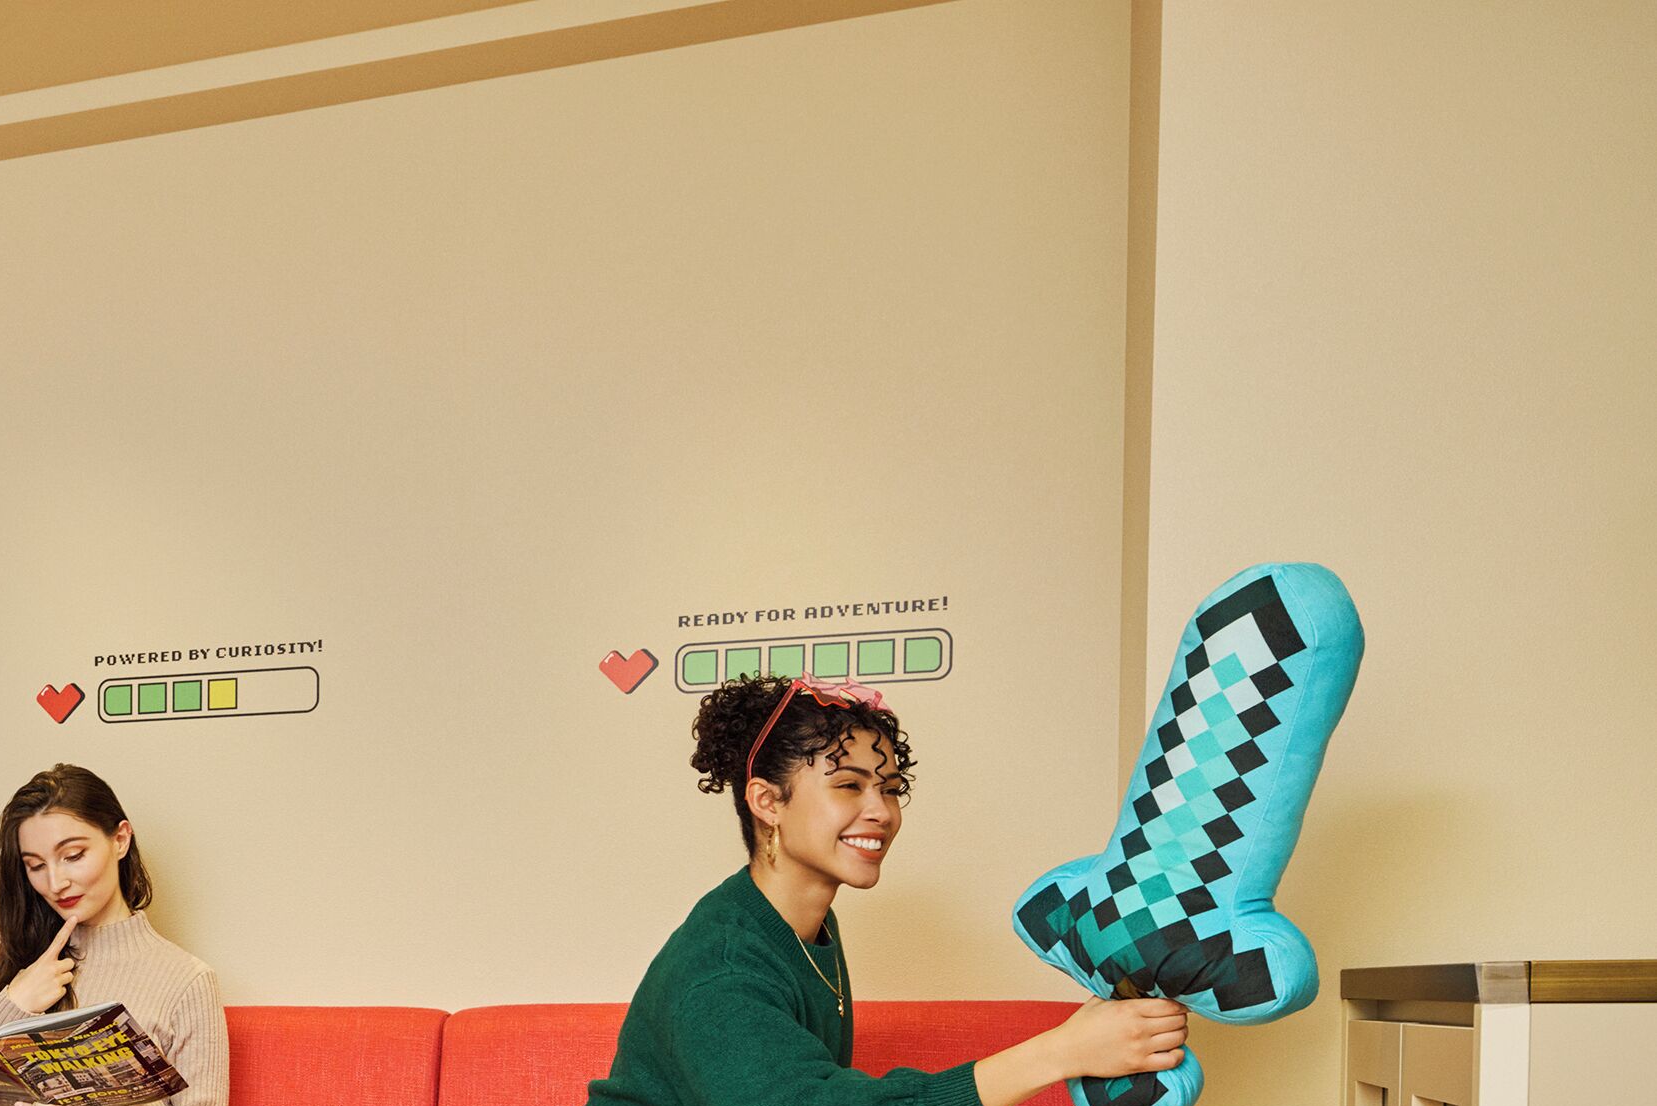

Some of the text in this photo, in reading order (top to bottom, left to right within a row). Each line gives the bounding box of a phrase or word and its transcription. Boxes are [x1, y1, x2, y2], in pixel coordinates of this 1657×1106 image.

[678, 595, 948, 628] READY FOR ADVENTURE!
[94, 638, 323, 668] POWERED BY CURIOSITY!
[21, 1044, 92, 1063] TOKYO
[91, 1031, 130, 1052] EYE
[38, 1047, 135, 1075] WALKING
